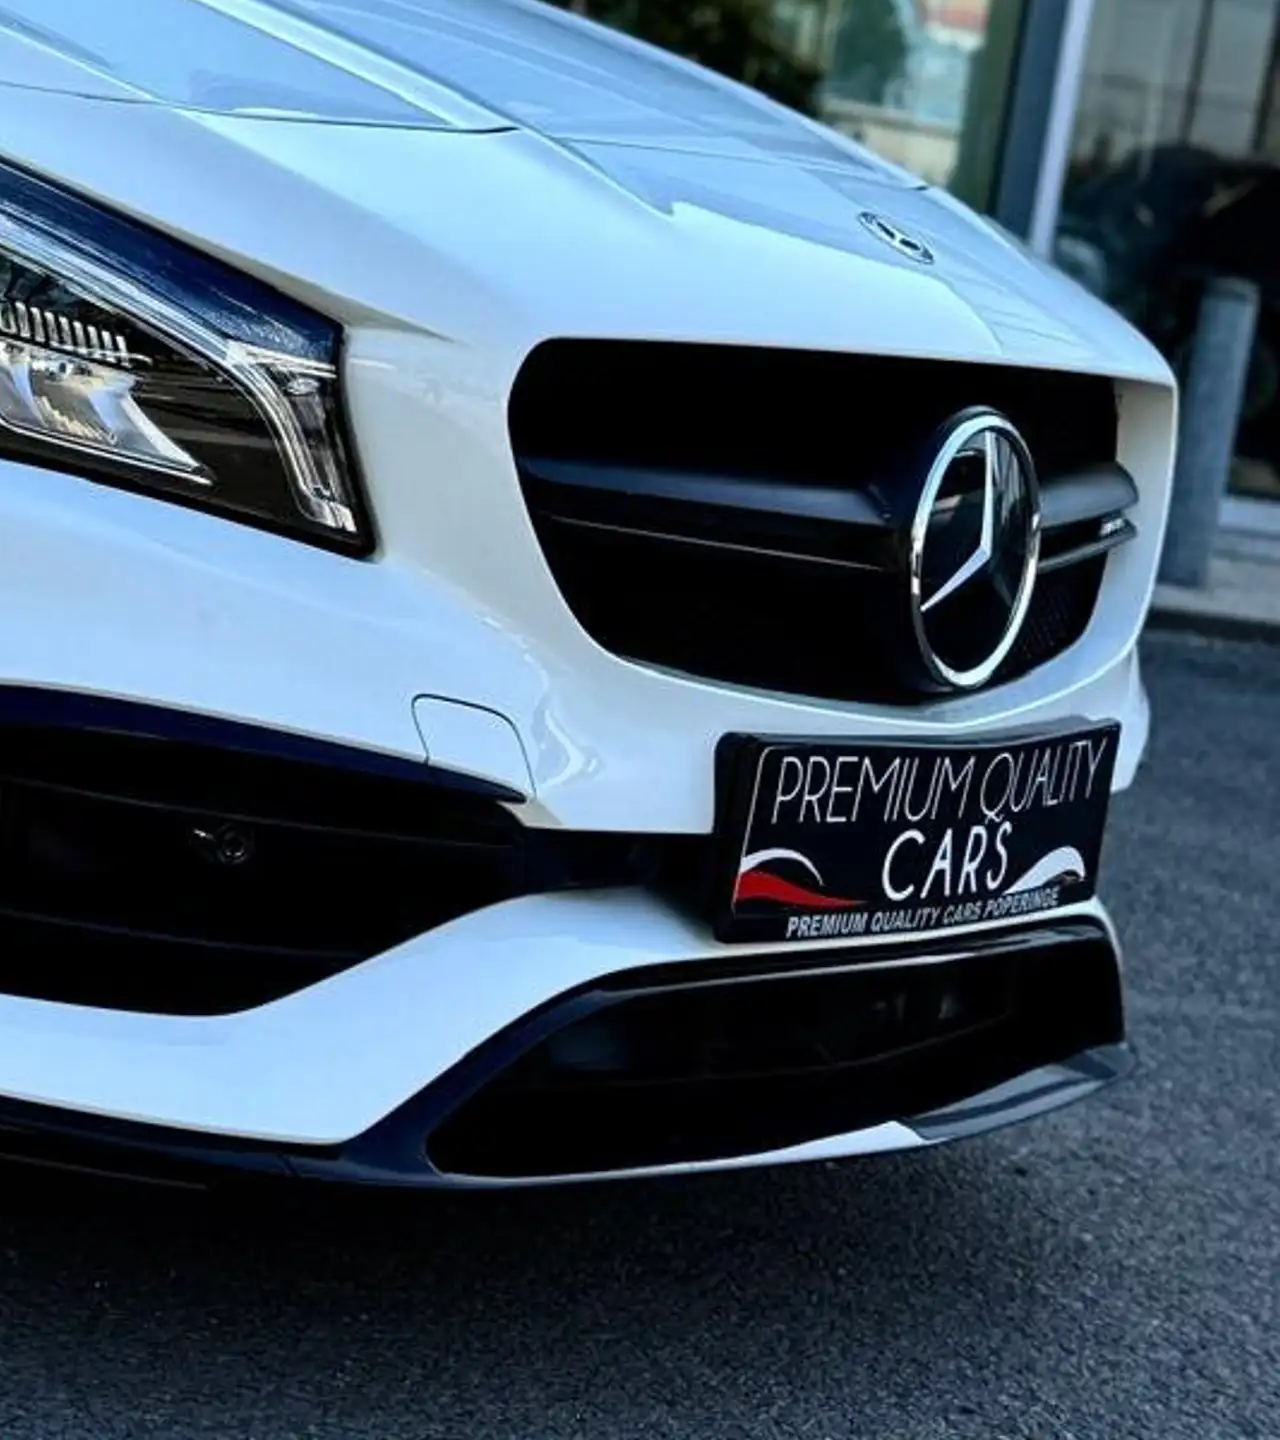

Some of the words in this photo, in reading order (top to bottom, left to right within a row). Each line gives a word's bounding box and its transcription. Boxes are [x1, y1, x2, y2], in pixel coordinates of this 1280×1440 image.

[771, 755, 976, 824] PREMIUM
[980, 738, 1107, 824] QUALITY
[882, 823, 1012, 901] CARS
[786, 914, 868, 938] PREMIUM
[870, 907, 942, 930] QUALITY
[942, 900, 982, 923] CARS
[982, 888, 1060, 918] POPERINGE
